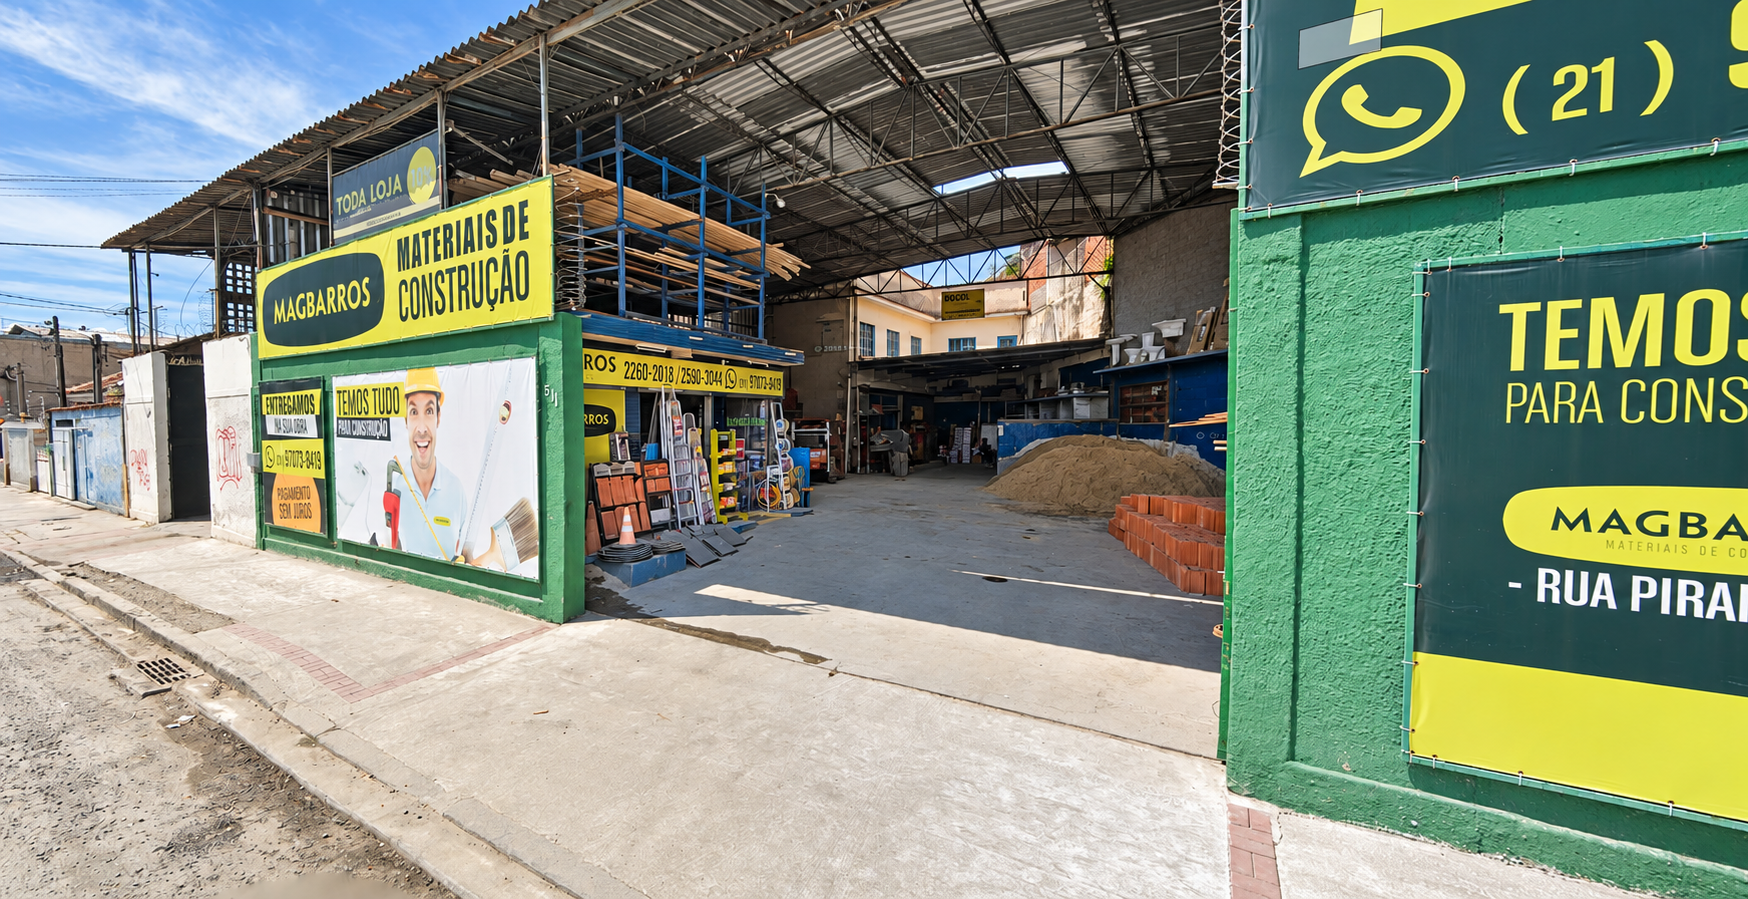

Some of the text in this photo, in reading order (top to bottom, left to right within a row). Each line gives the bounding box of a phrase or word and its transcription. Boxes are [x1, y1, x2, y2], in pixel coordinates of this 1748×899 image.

[336, 187, 367, 216] TODA
[370, 173, 403, 203] LOJA
[396, 199, 530, 273] MATERIAIS DE
[273, 276, 371, 325] MAGBARROS
[398, 247, 530, 323] CONSTRUÇÃO
[1499, 288, 1748, 372] TEMO
[583, 353, 616, 373] ROS
[623, 360, 674, 383] 2260-2018
[266, 394, 315, 415] ENTREGAMOS
[336, 385, 400, 416] TEMOS TUDO
[1505, 376, 1748, 424] PARA CONS
[1550, 506, 1748, 541] MAGBA
[1605, 539, 1748, 559] MATERIAIS DE CO
[1536, 567, 1618, 610] RUA
